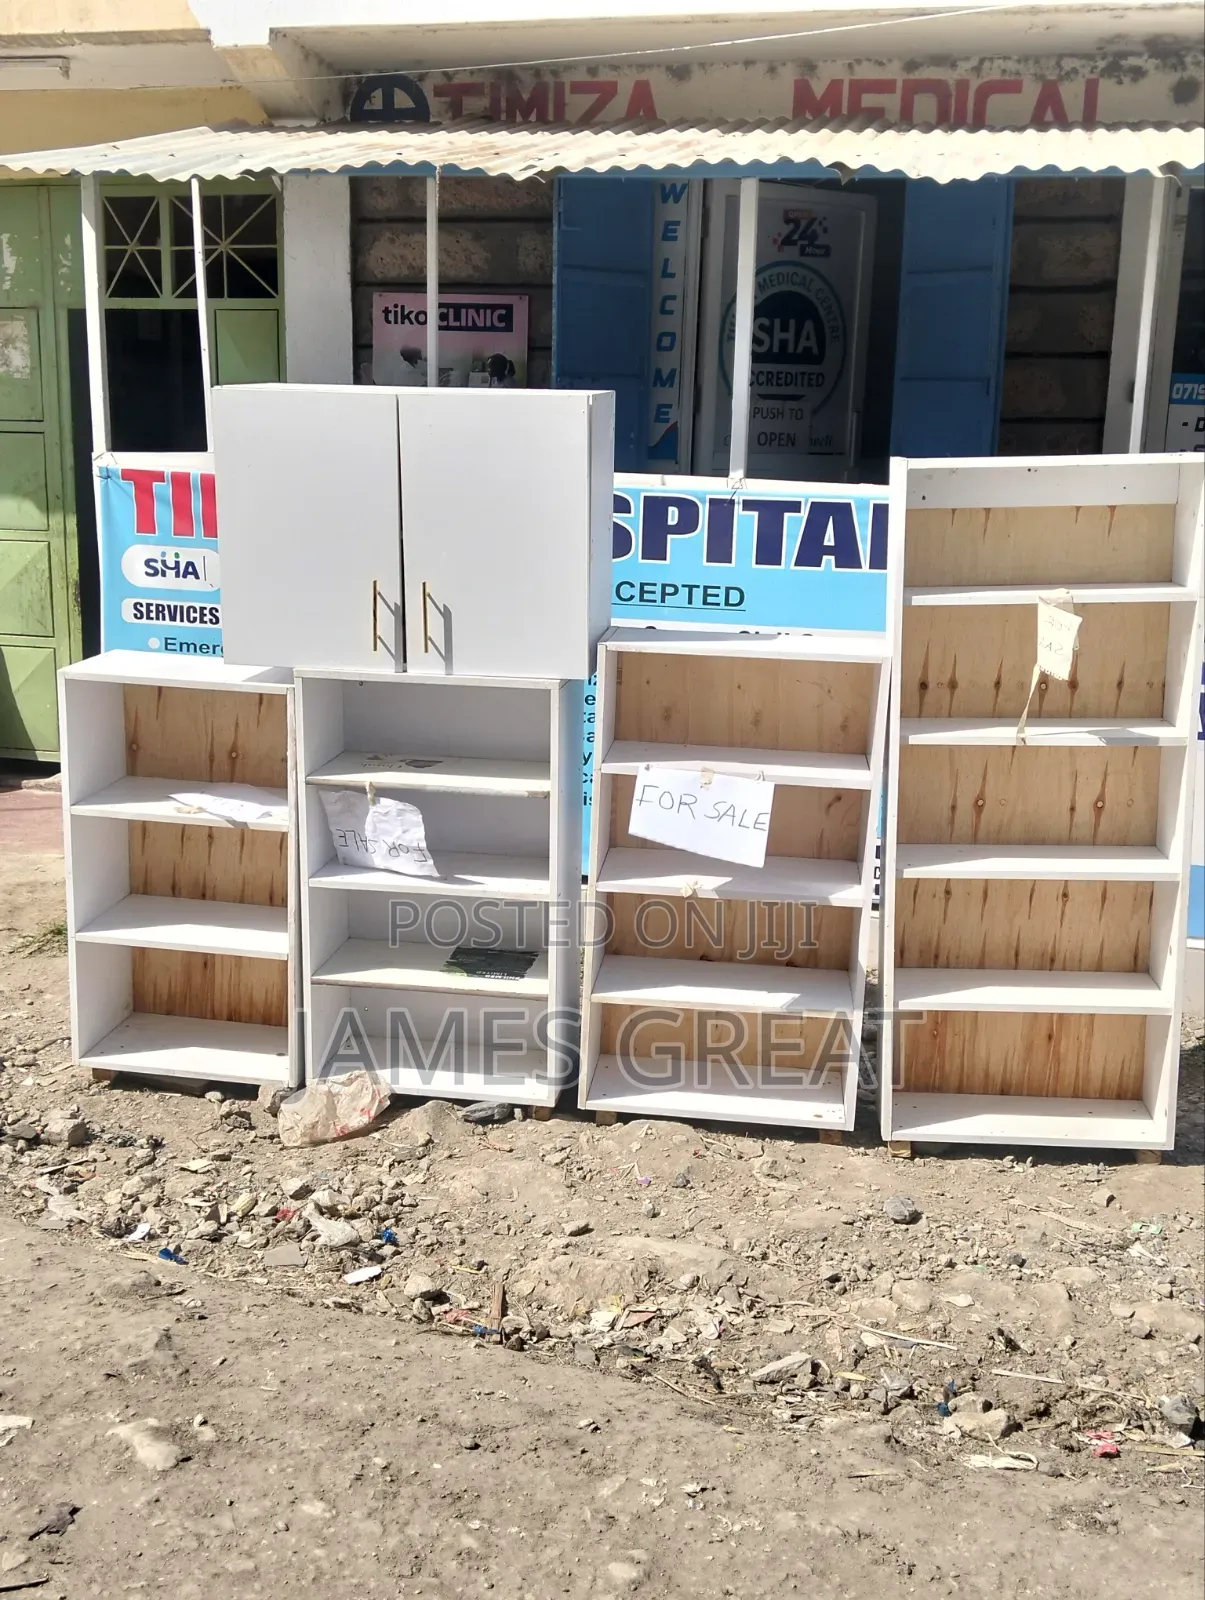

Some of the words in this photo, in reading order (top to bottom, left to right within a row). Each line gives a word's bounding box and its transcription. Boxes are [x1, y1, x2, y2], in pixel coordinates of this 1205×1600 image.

[433, 80, 659, 124] TIMIZA
[780, 217, 819, 247] 24
[382, 303, 428, 325] tiko
[437, 307, 507, 328] CLINIC
[652, 183, 688, 424] WELCOME
[757, 271, 814, 292] MEDICAL
[816, 288, 841, 344] CENTRE
[751, 317, 819, 357] SHA
[749, 370, 825, 389] CCREDITED
[752, 406, 785, 421] PUSH
[788, 407, 804, 421] TO
[756, 431, 797, 447] OPEN
[144, 551, 200, 581] SHA
[133, 602, 220, 625] SERVICES
[164, 637, 224, 657] Emer
[635, 784, 698, 820] FOR
[704, 801, 770, 832] SALE
[335, 828, 378, 855] SALE
[381, 842, 428, 863] FOR
